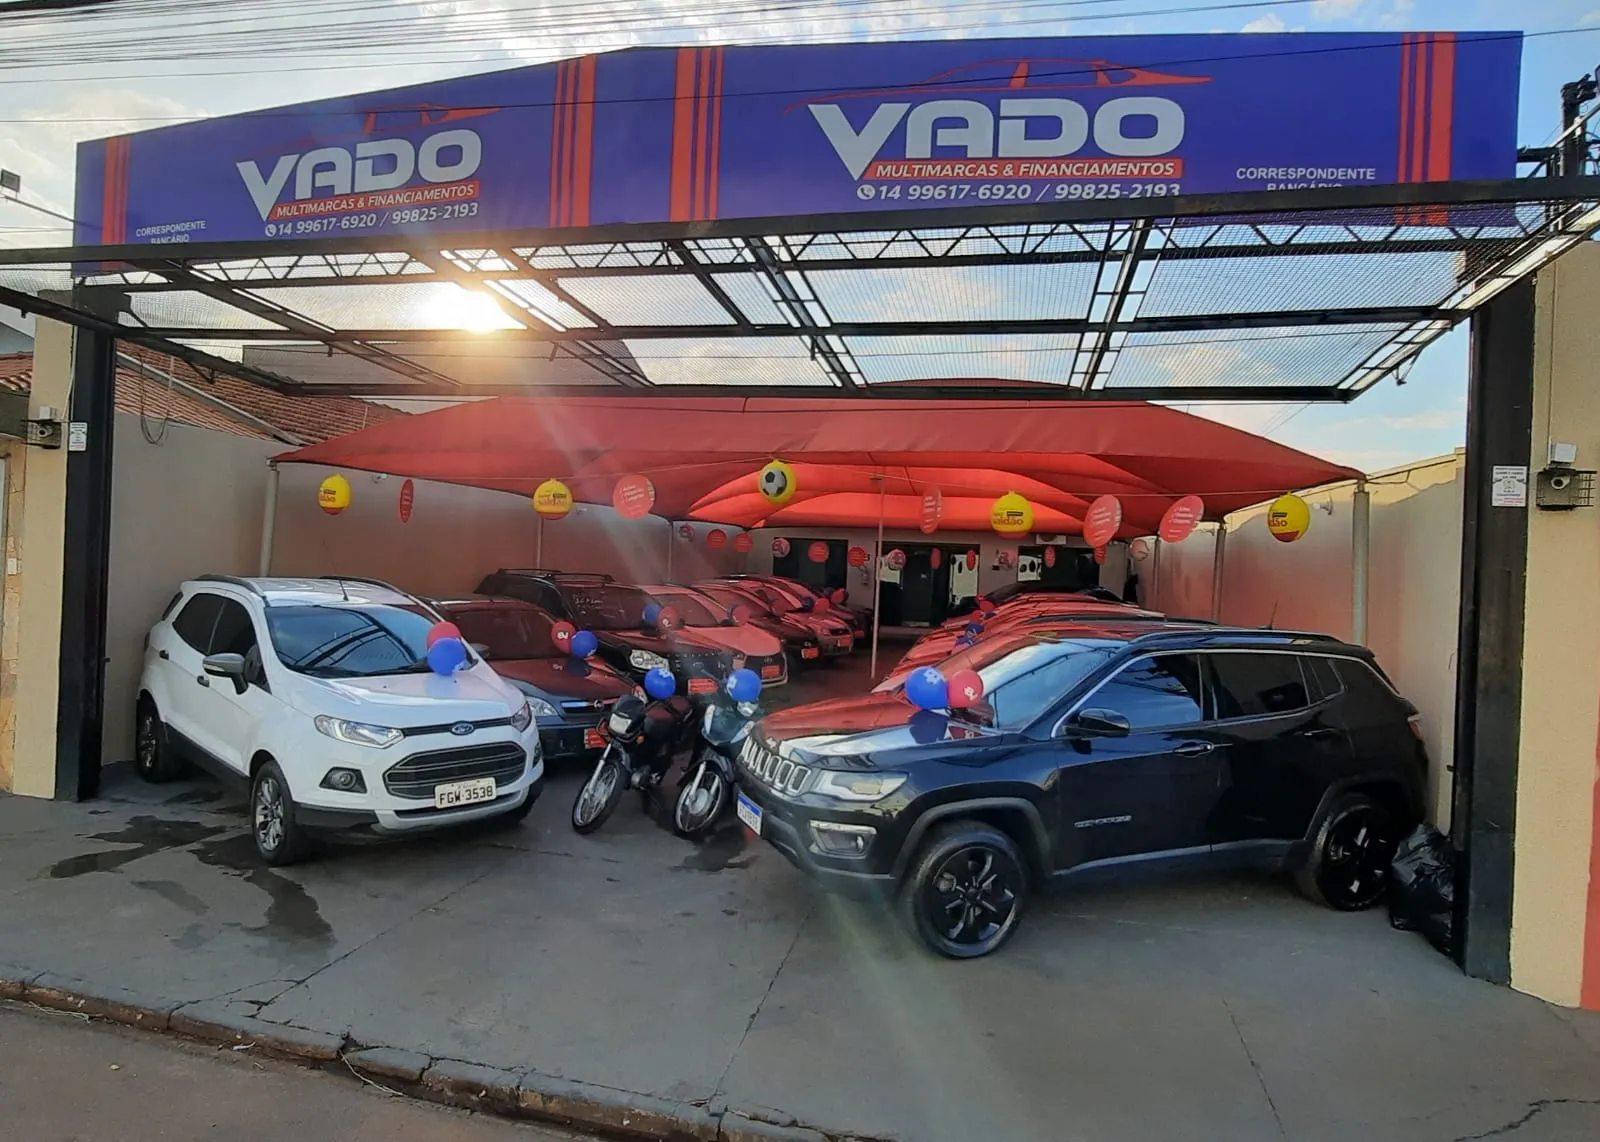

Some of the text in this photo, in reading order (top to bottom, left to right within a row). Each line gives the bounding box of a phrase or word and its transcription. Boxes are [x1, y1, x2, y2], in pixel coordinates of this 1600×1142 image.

[807, 97, 1185, 182] VADO
[236, 129, 482, 222] VADO
[876, 162, 1175, 177] MULTIMARCAS & FINANCIAMENTOS
[1236, 167, 1377, 180] CORRESPONDENTE
[276, 184, 475, 218] MULTIMARCAS & FINANCIAMENTOS
[879, 185, 901, 200] 14
[907, 184, 1032, 200] 99617-6920
[1054, 183, 1181, 200] 99825-2193
[136, 220, 207, 237] CORRESPONDENTE
[278, 223, 292, 236] 14
[295, 213, 377, 234] 99617-6920
[391, 202, 479, 225] 99825-2193
